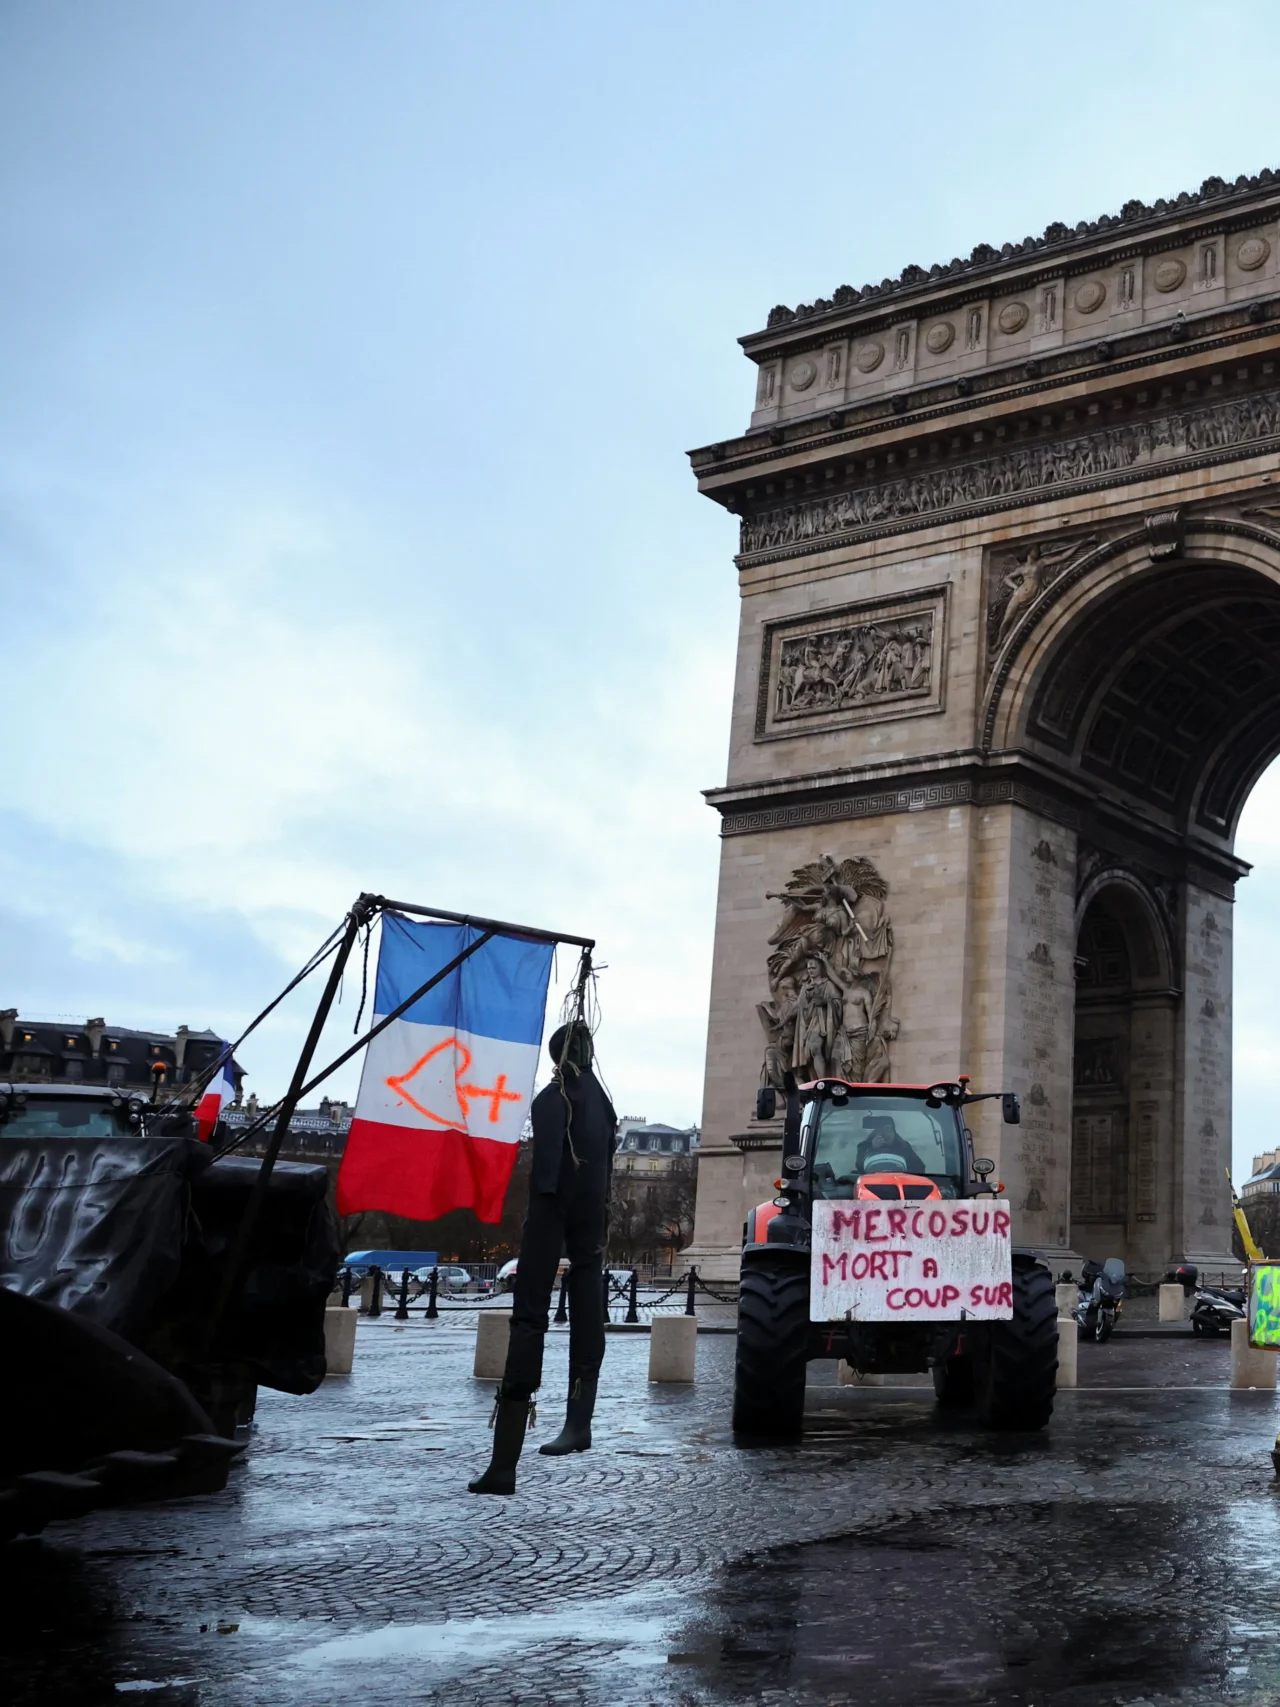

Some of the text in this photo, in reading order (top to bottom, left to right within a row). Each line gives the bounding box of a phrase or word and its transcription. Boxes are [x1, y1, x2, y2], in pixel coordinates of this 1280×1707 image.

[832, 1209, 1011, 1241] MERCOSUR
[822, 1250, 938, 1285] MORT A
[886, 1281, 1013, 1310] COUP SUR
